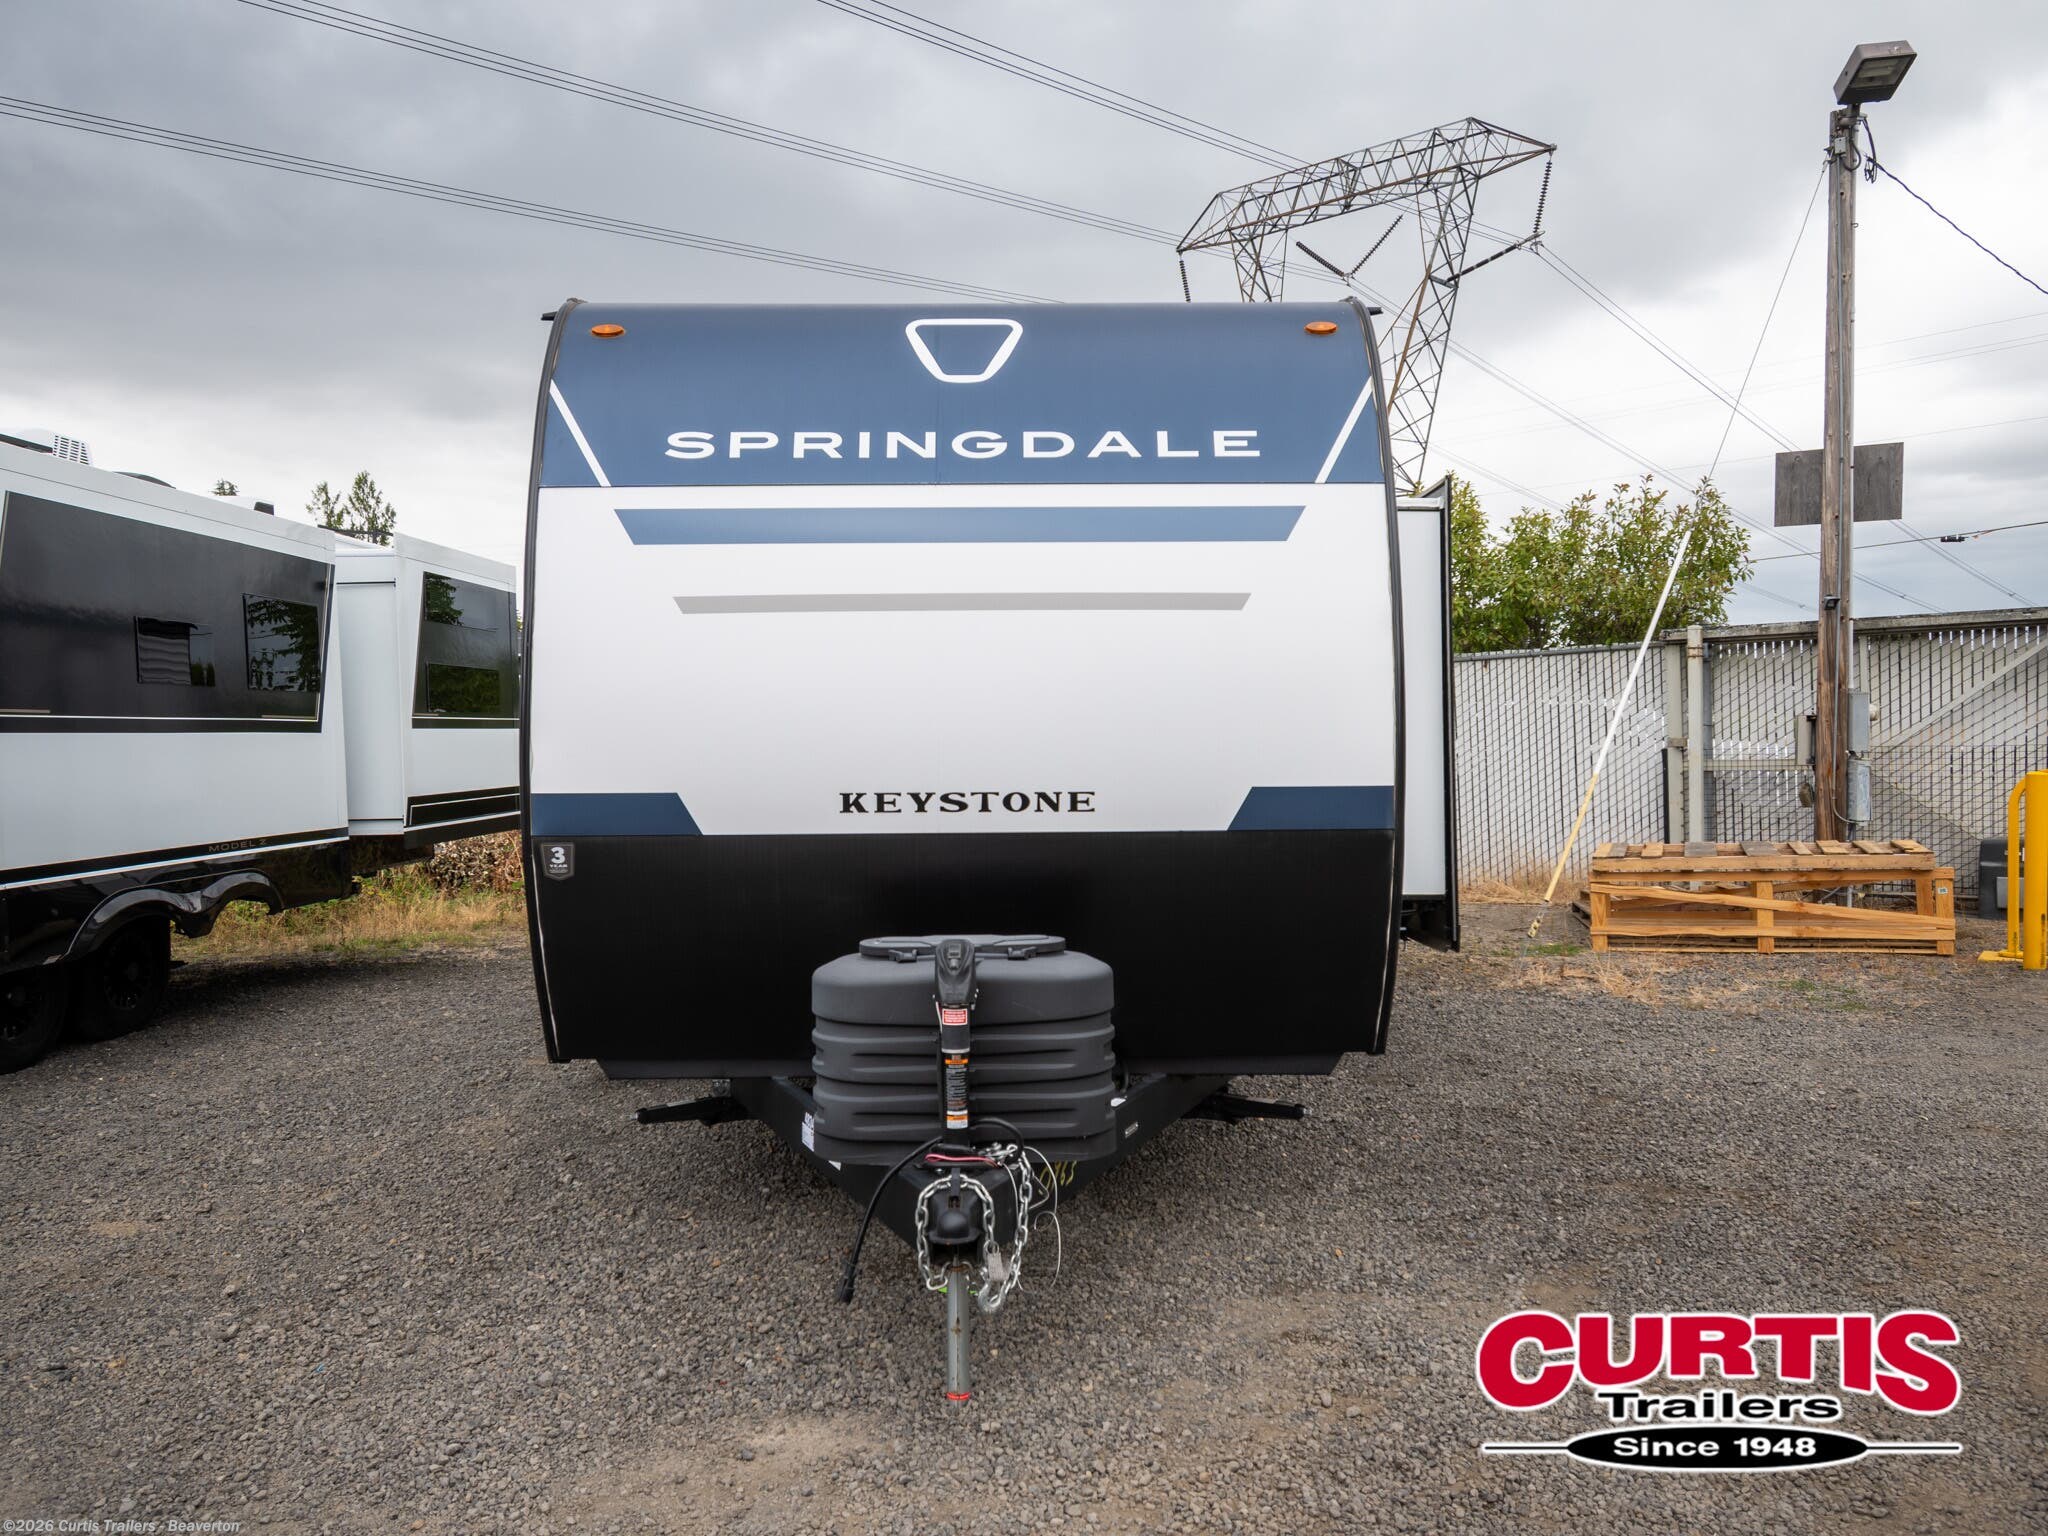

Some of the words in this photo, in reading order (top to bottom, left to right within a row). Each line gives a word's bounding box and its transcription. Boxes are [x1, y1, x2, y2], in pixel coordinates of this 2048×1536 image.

[664, 430, 1261, 460] SPRINGDALE
[839, 791, 1096, 814] KEYSTONE
[208, 839, 257, 853] MODEL
[551, 846, 566, 864] 3
